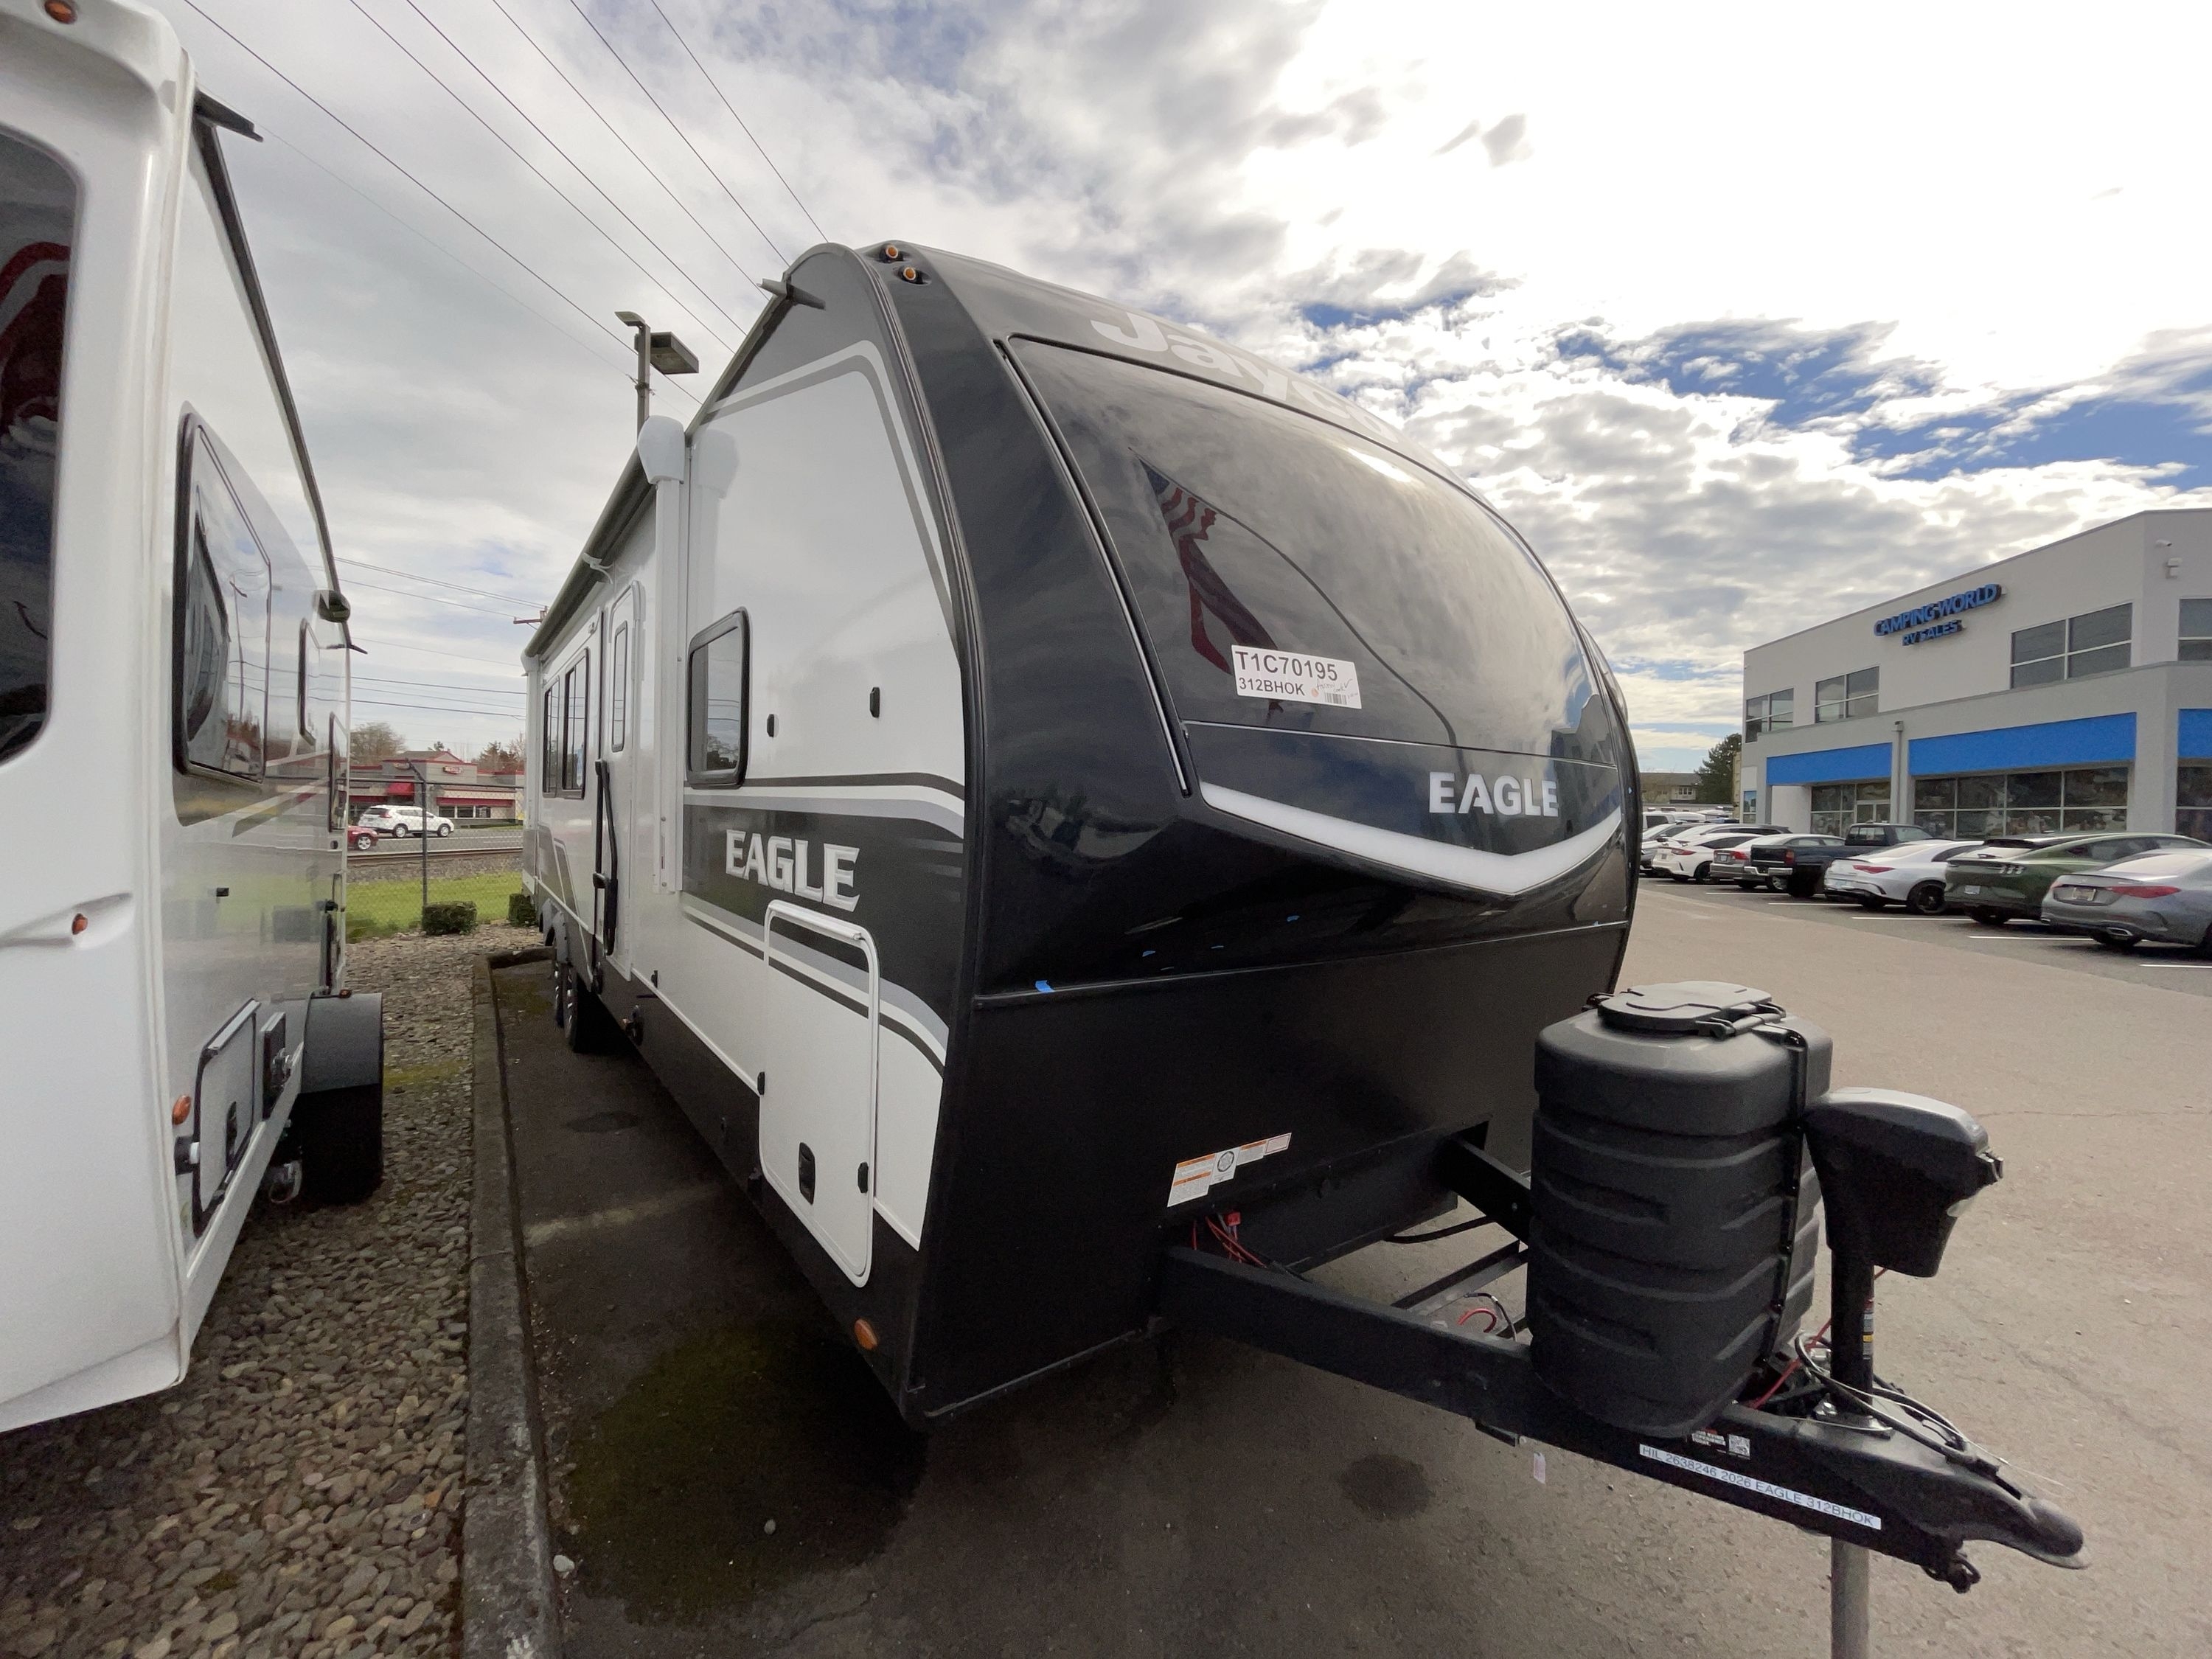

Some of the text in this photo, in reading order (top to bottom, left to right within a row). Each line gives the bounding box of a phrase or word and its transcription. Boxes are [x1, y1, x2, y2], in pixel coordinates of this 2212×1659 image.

[1091, 311, 1399, 443] Jayco
[1874, 583, 2001, 636] CAMPING WORLD
[1902, 622, 1962, 646] RV SALES
[1235, 651, 1338, 681] T1C70195
[1239, 678, 1305, 695] 312BHOK
[1429, 771, 1559, 817] EAGLE
[726, 829, 860, 912] EAGLE
[1666, 1453, 1717, 1477] 2638246
[1720, 1471, 1751, 1489] 2026
[1756, 1481, 1802, 1504] EAGLE
[1806, 1492, 1874, 1526] 312BHOK
